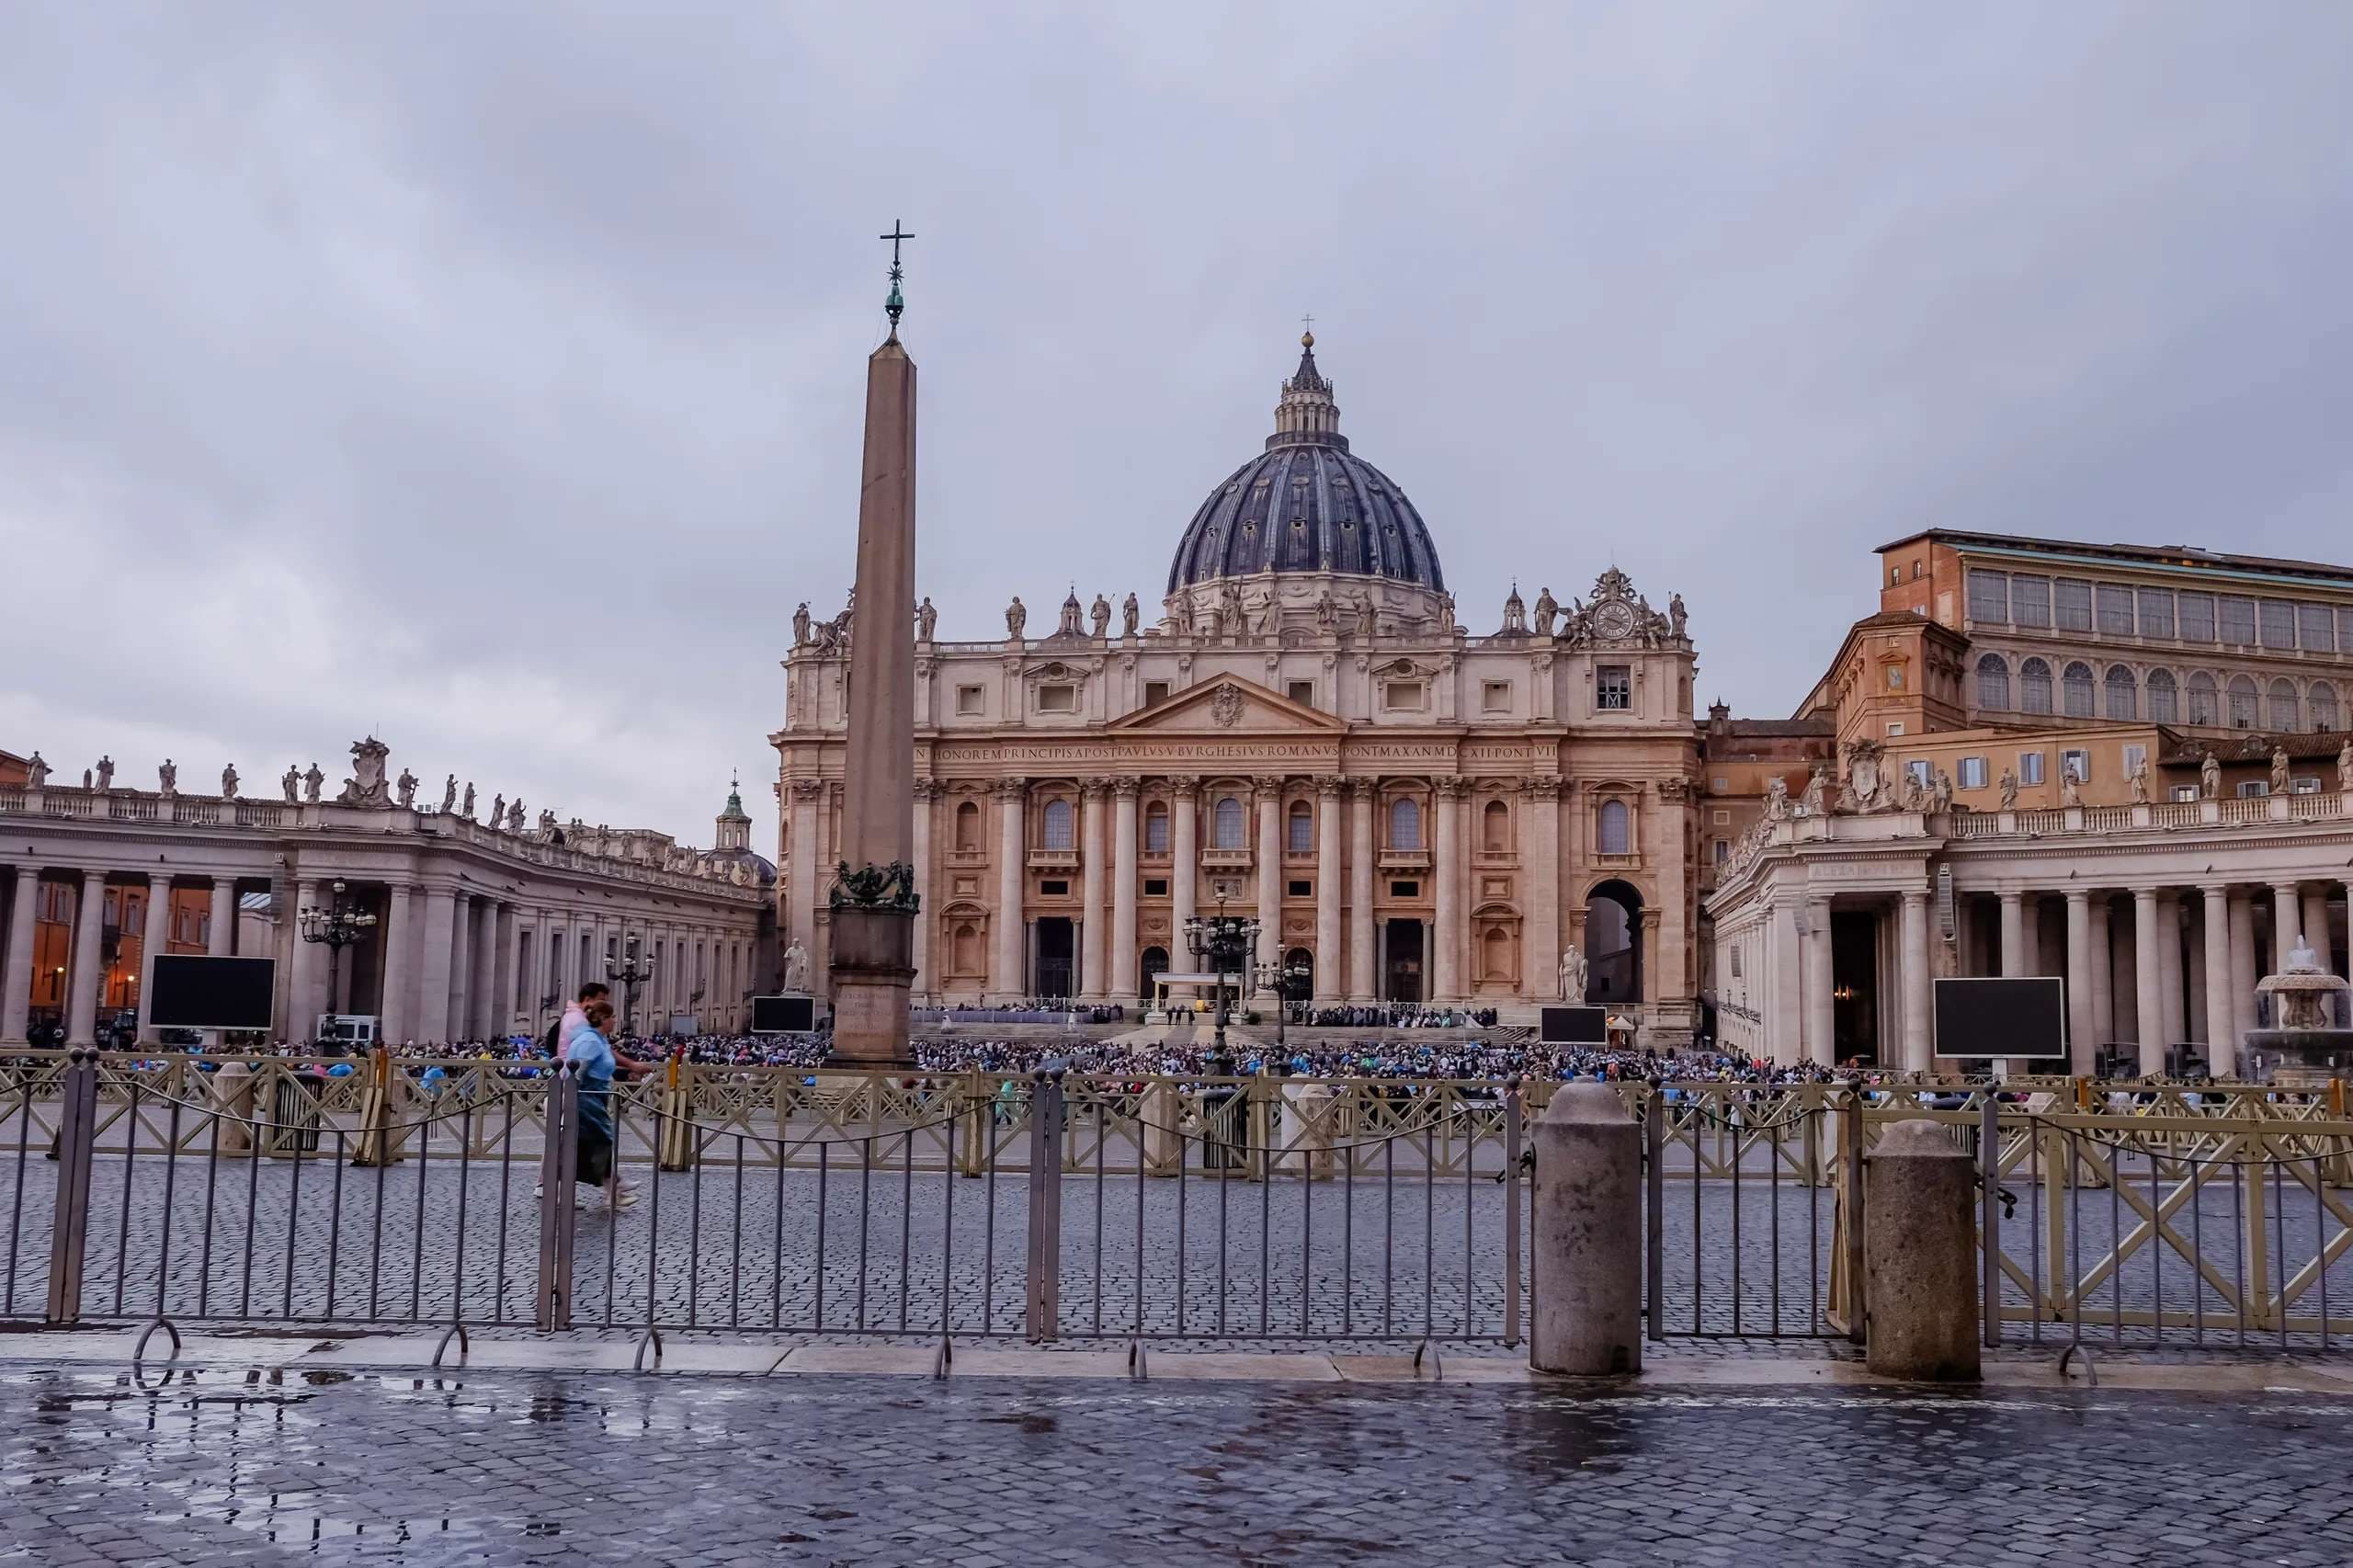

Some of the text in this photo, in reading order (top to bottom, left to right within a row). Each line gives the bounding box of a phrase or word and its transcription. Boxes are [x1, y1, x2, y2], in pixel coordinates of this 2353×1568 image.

[933, 748, 1001, 760] HONOREM
[1005, 747, 1074, 759] PRINCIPIS
[1074, 747, 1118, 759] APOST
[1118, 745, 1164, 757] PAVLVS
[1178, 745, 1264, 757] BVRGHESIVS
[1267, 745, 1338, 756] ROMANVS
[1343, 745, 1381, 757] PONT
[1381, 745, 1413, 757] MAX
[1495, 747, 1533, 759] PONT
[1536, 745, 1556, 757] VII
